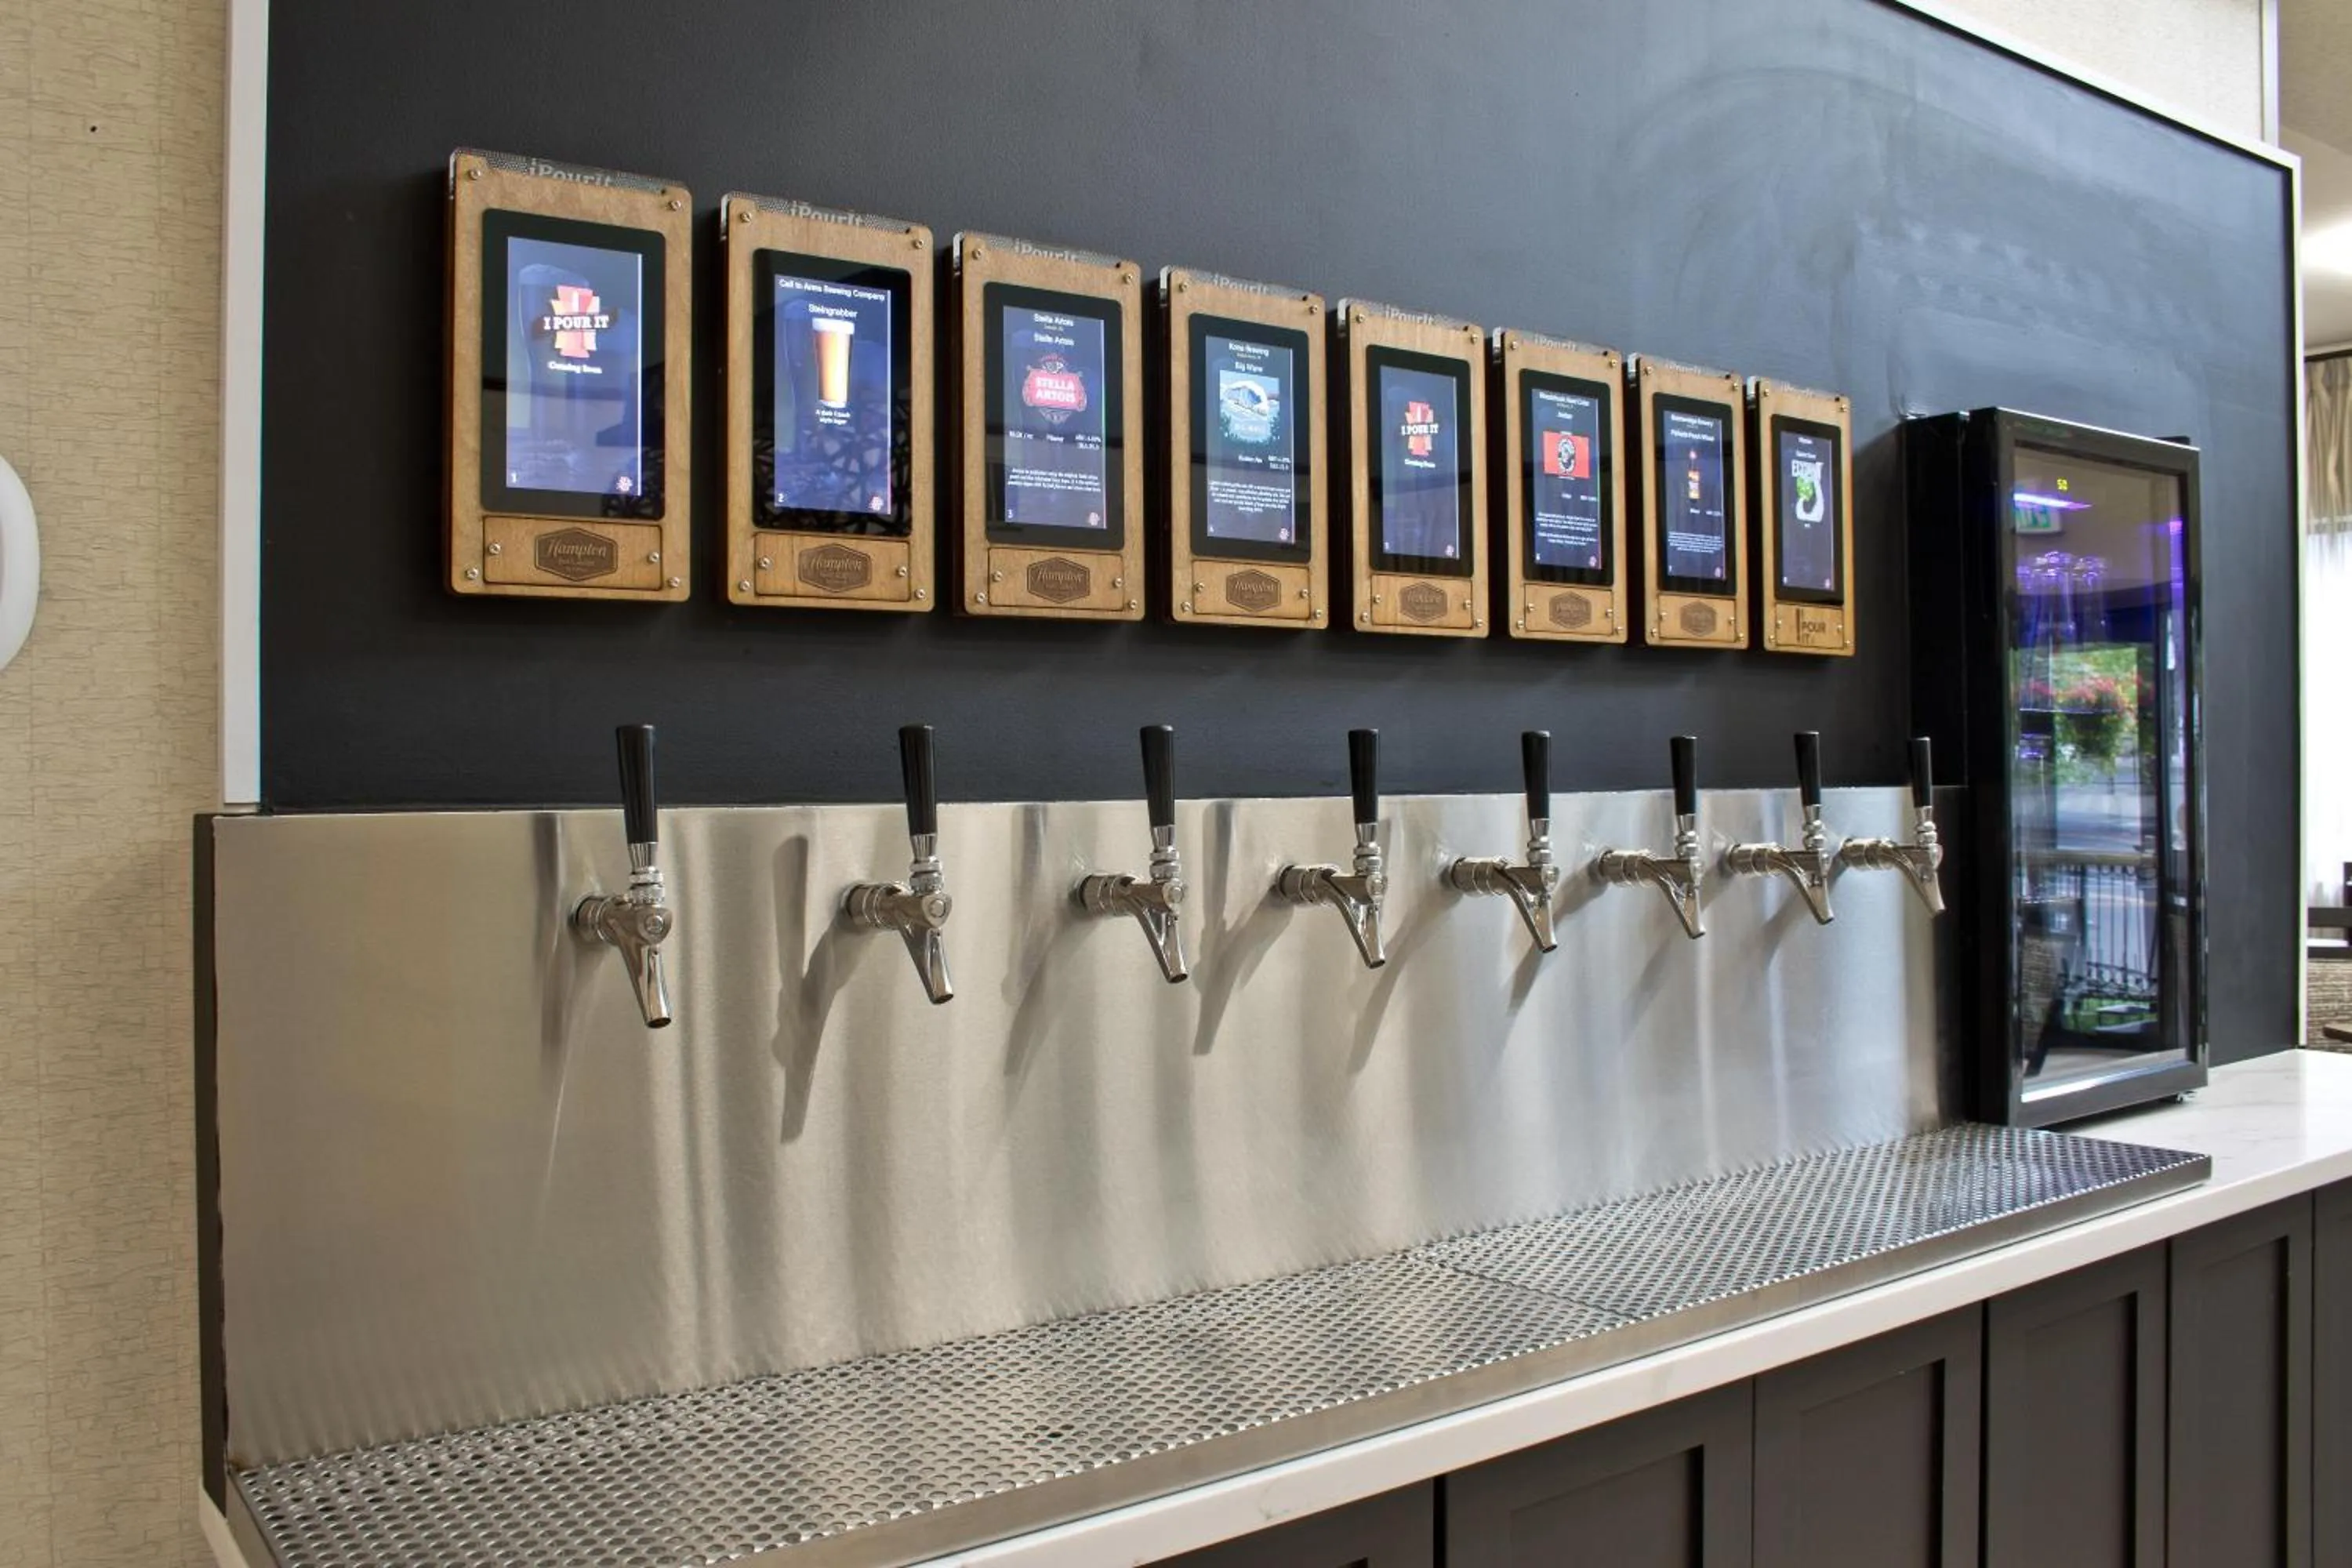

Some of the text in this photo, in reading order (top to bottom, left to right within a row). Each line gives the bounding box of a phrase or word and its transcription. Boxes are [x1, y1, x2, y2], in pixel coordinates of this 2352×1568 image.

[543, 315, 609, 330] I POUR IT
[1035, 376, 1075, 390] STELLA
[1035, 389, 1076, 402] ARTOIS
[547, 539, 606, 559] Hampton
